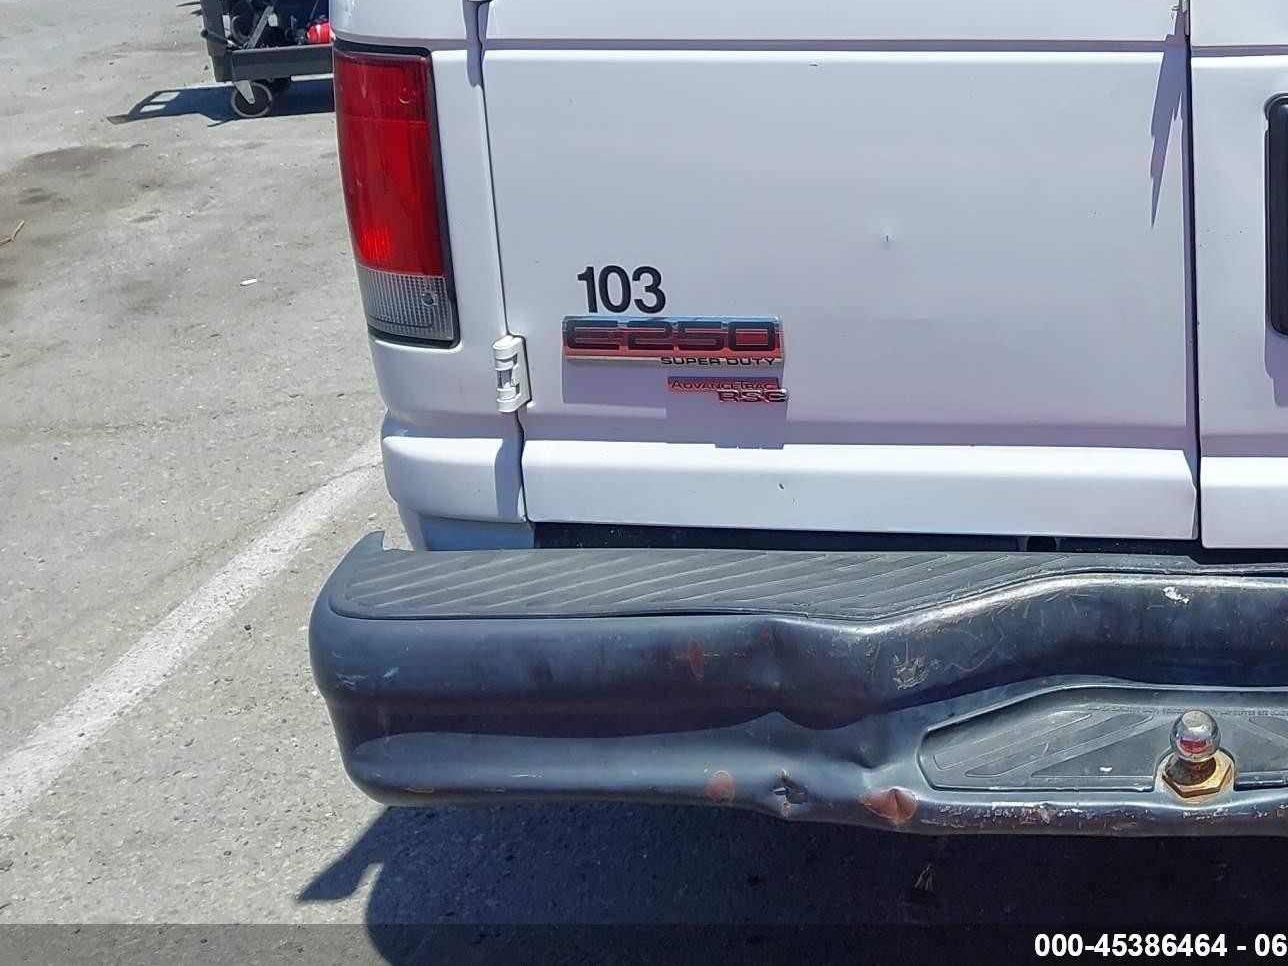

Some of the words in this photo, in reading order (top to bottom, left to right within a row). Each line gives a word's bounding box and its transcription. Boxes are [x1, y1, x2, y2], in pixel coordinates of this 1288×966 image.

[577, 265, 667, 314] 103
[660, 356, 721, 366] SUPER
[727, 357, 776, 366] DUTY
[717, 388, 789, 403] RSC
